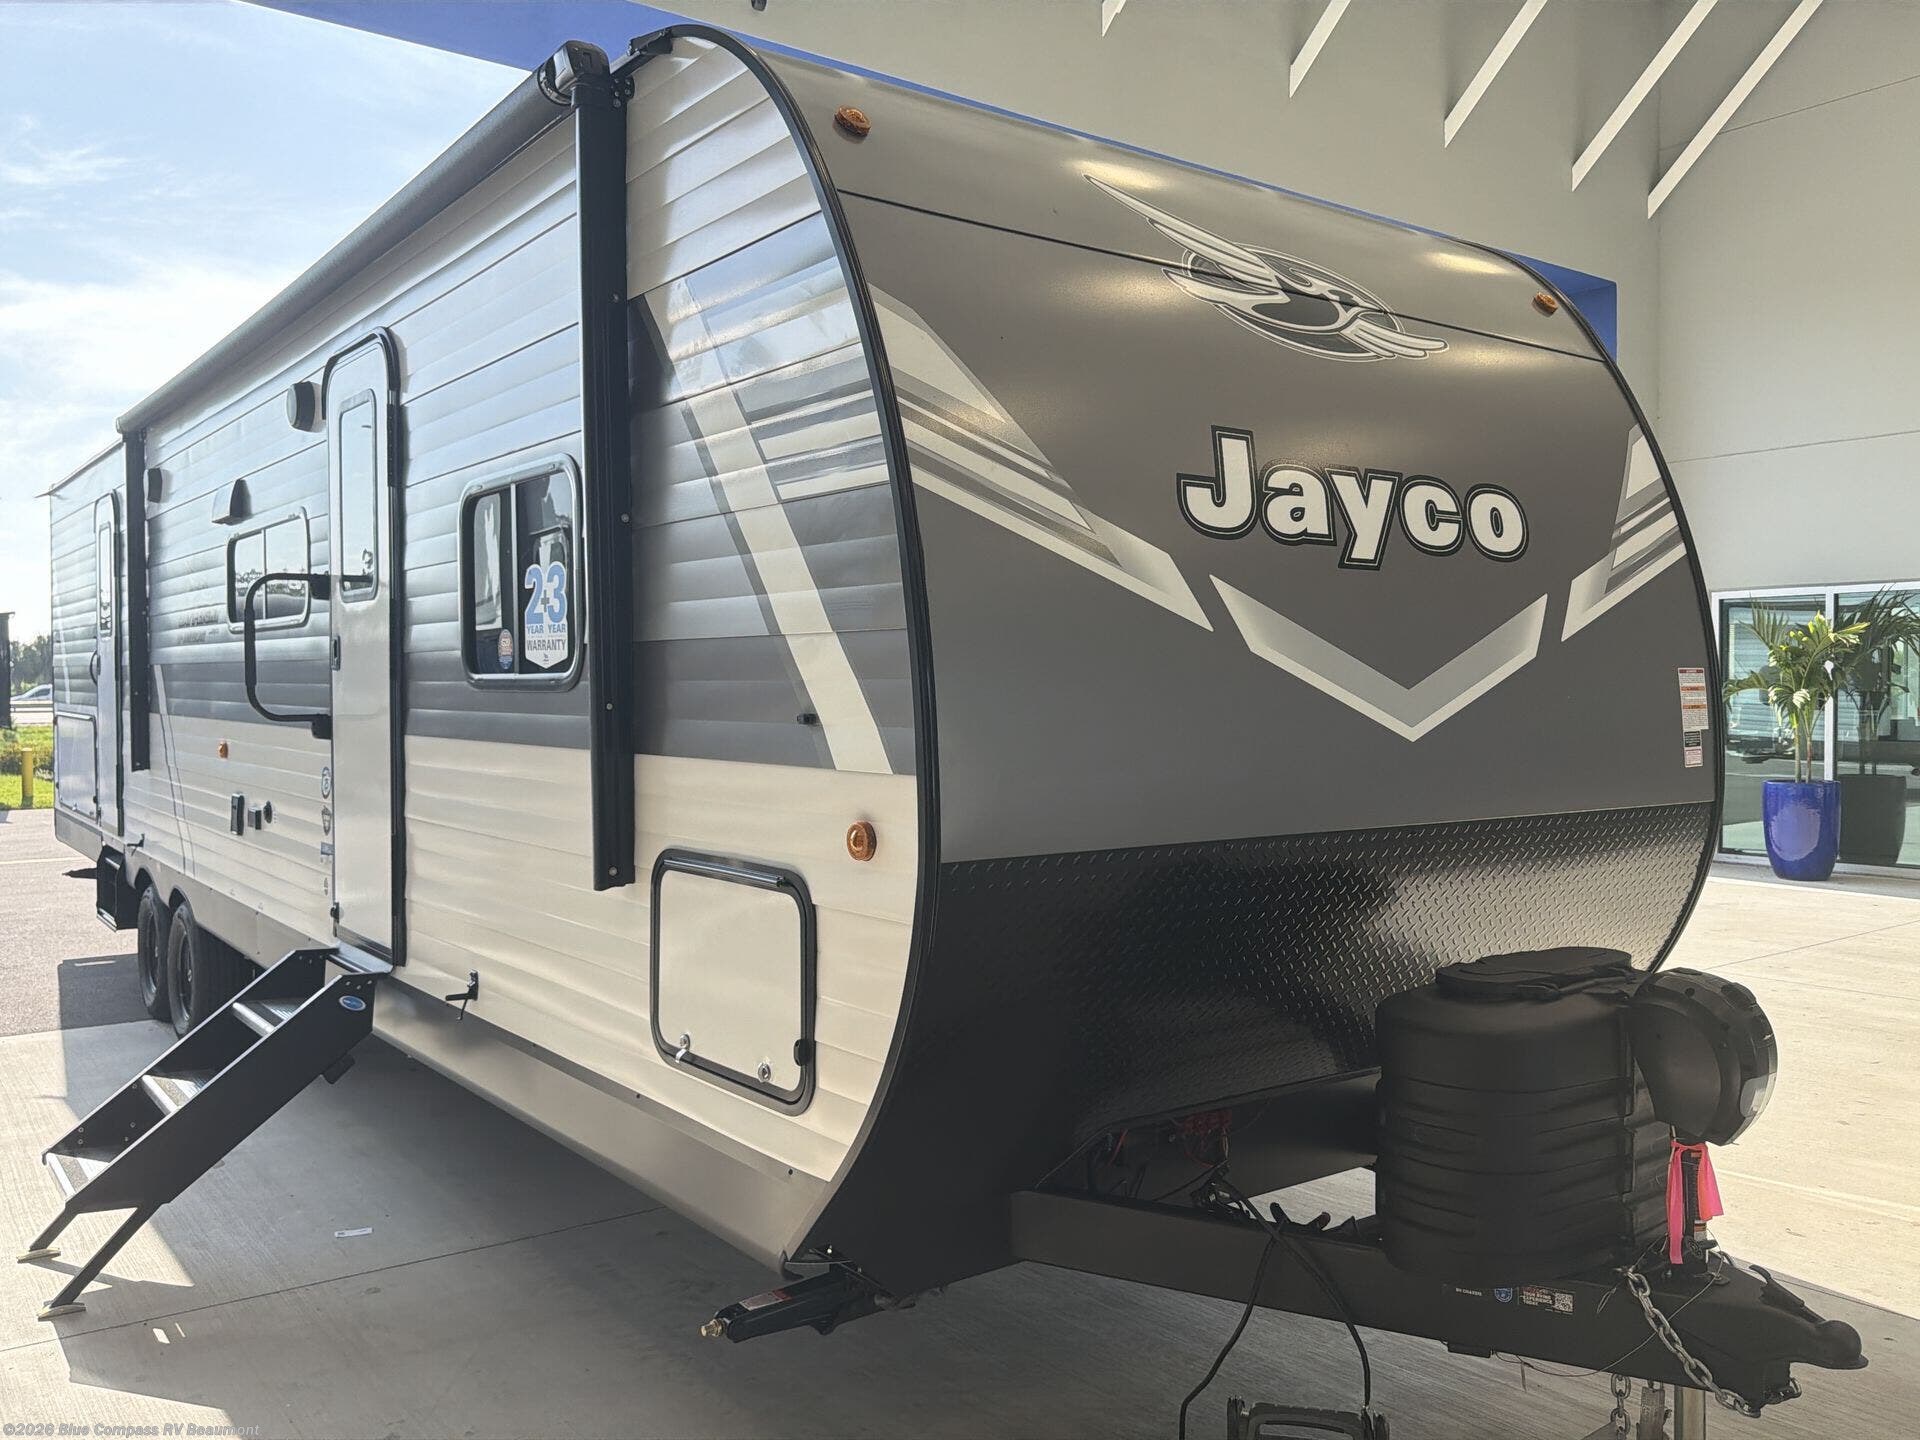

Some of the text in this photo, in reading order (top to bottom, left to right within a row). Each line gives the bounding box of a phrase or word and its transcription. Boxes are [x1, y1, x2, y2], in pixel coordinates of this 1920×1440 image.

[1177, 425, 1530, 571] Jayco
[527, 624, 566, 634] YEAR YEAR
[527, 639, 566, 651] WARRANTY
